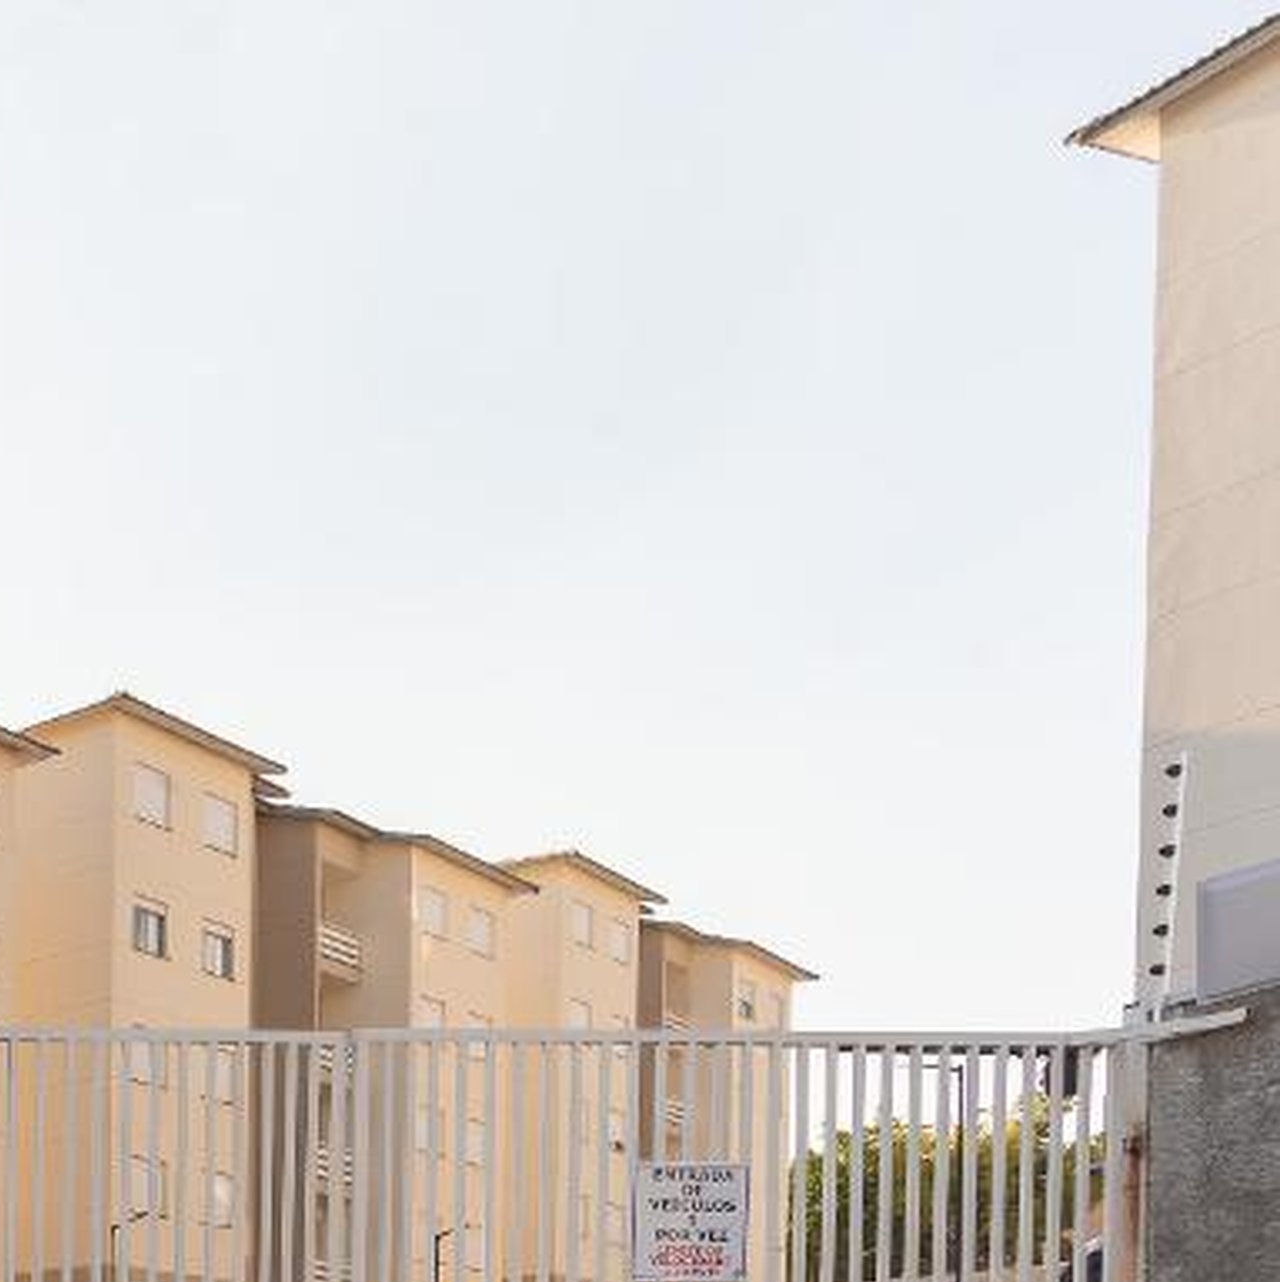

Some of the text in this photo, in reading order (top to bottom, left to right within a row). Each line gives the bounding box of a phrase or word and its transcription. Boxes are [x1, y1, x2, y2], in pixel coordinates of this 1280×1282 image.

[652, 1167, 734, 1182] ENTRADA
[681, 1184, 702, 1196] DE
[655, 1228, 729, 1242] POR VEZ
